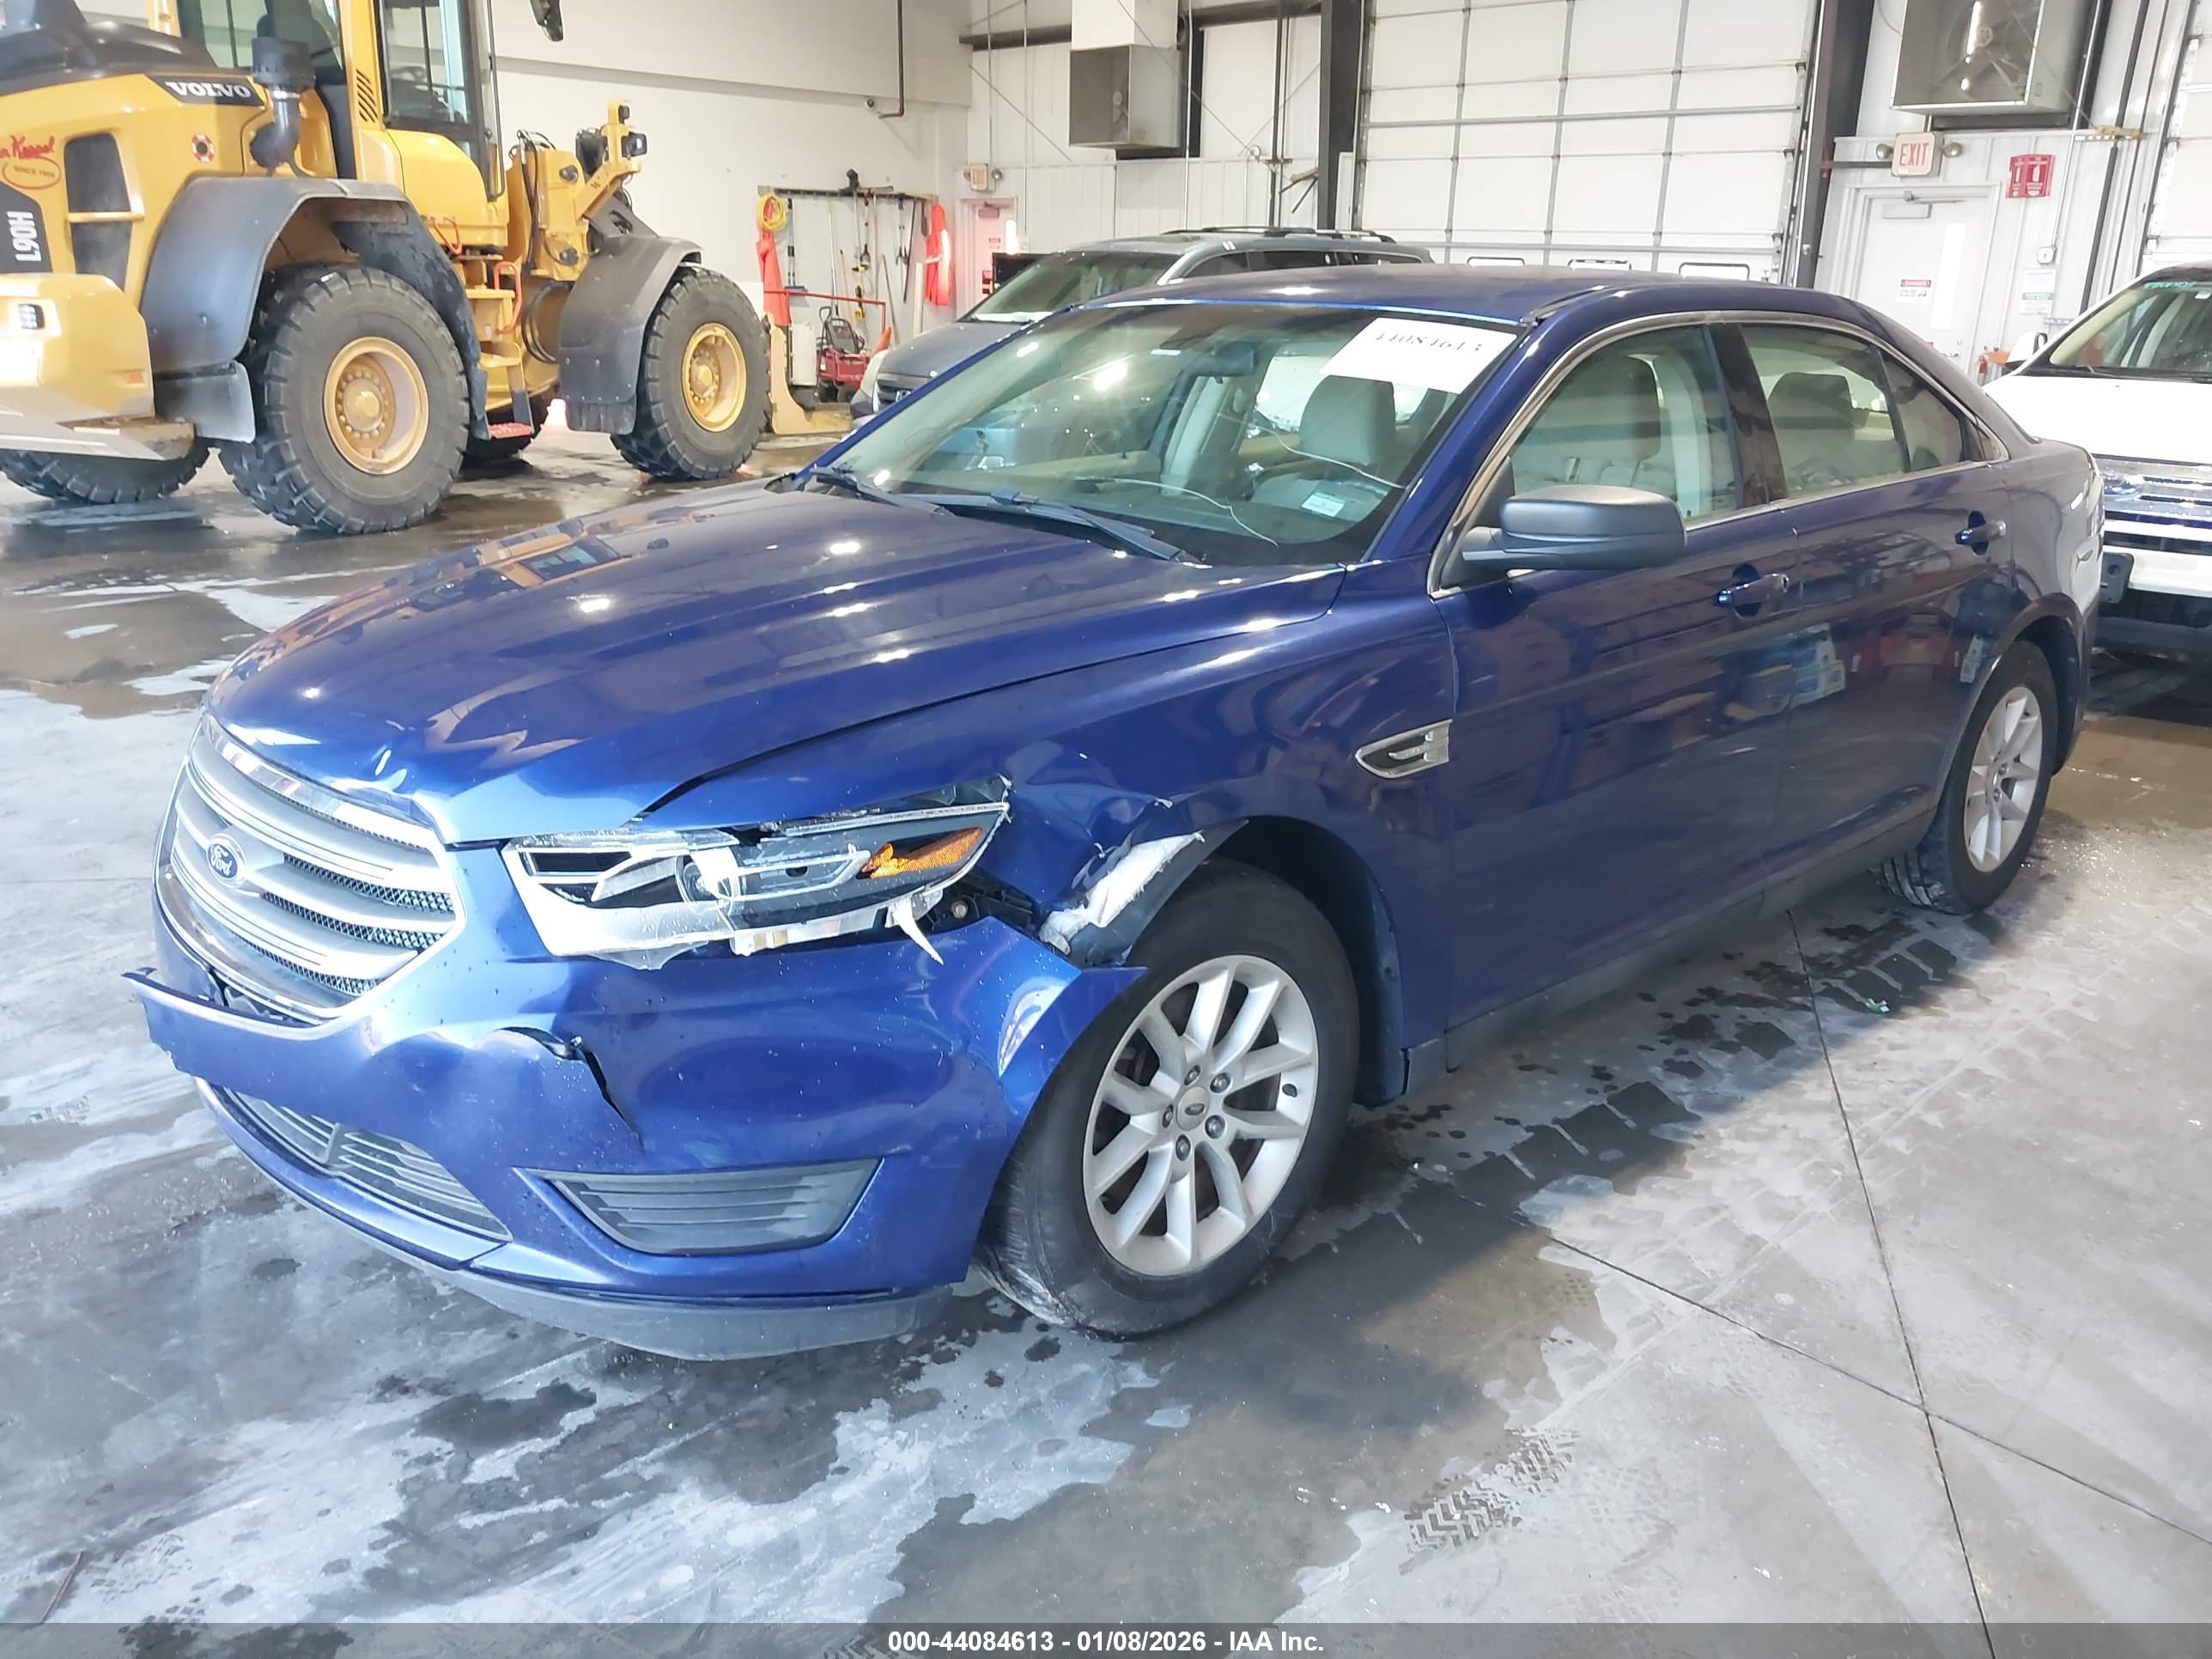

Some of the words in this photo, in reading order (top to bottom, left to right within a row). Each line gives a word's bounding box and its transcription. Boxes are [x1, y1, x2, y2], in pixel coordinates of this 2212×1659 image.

[164, 82, 251, 97] VOLVO
[1899, 143, 1929, 166] EXIT
[7, 211, 42, 261] L90H
[210, 845, 234, 877] Ford
